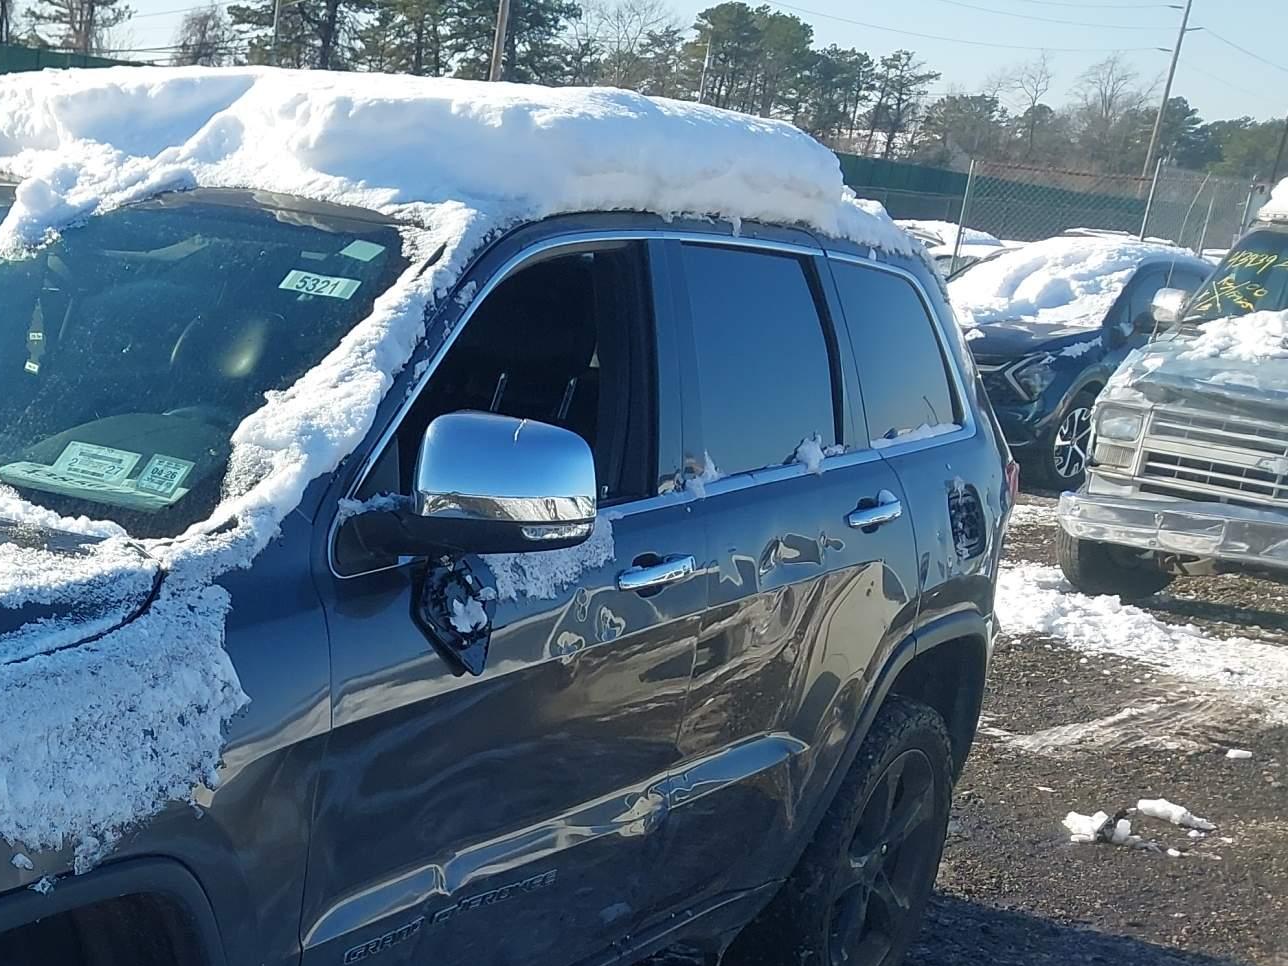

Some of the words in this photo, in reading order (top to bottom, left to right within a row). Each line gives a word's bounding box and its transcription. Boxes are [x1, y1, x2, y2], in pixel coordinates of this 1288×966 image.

[295, 275, 341, 295] 5321
[105, 465, 124, 476] 27
[344, 916, 425, 965] GRAND
